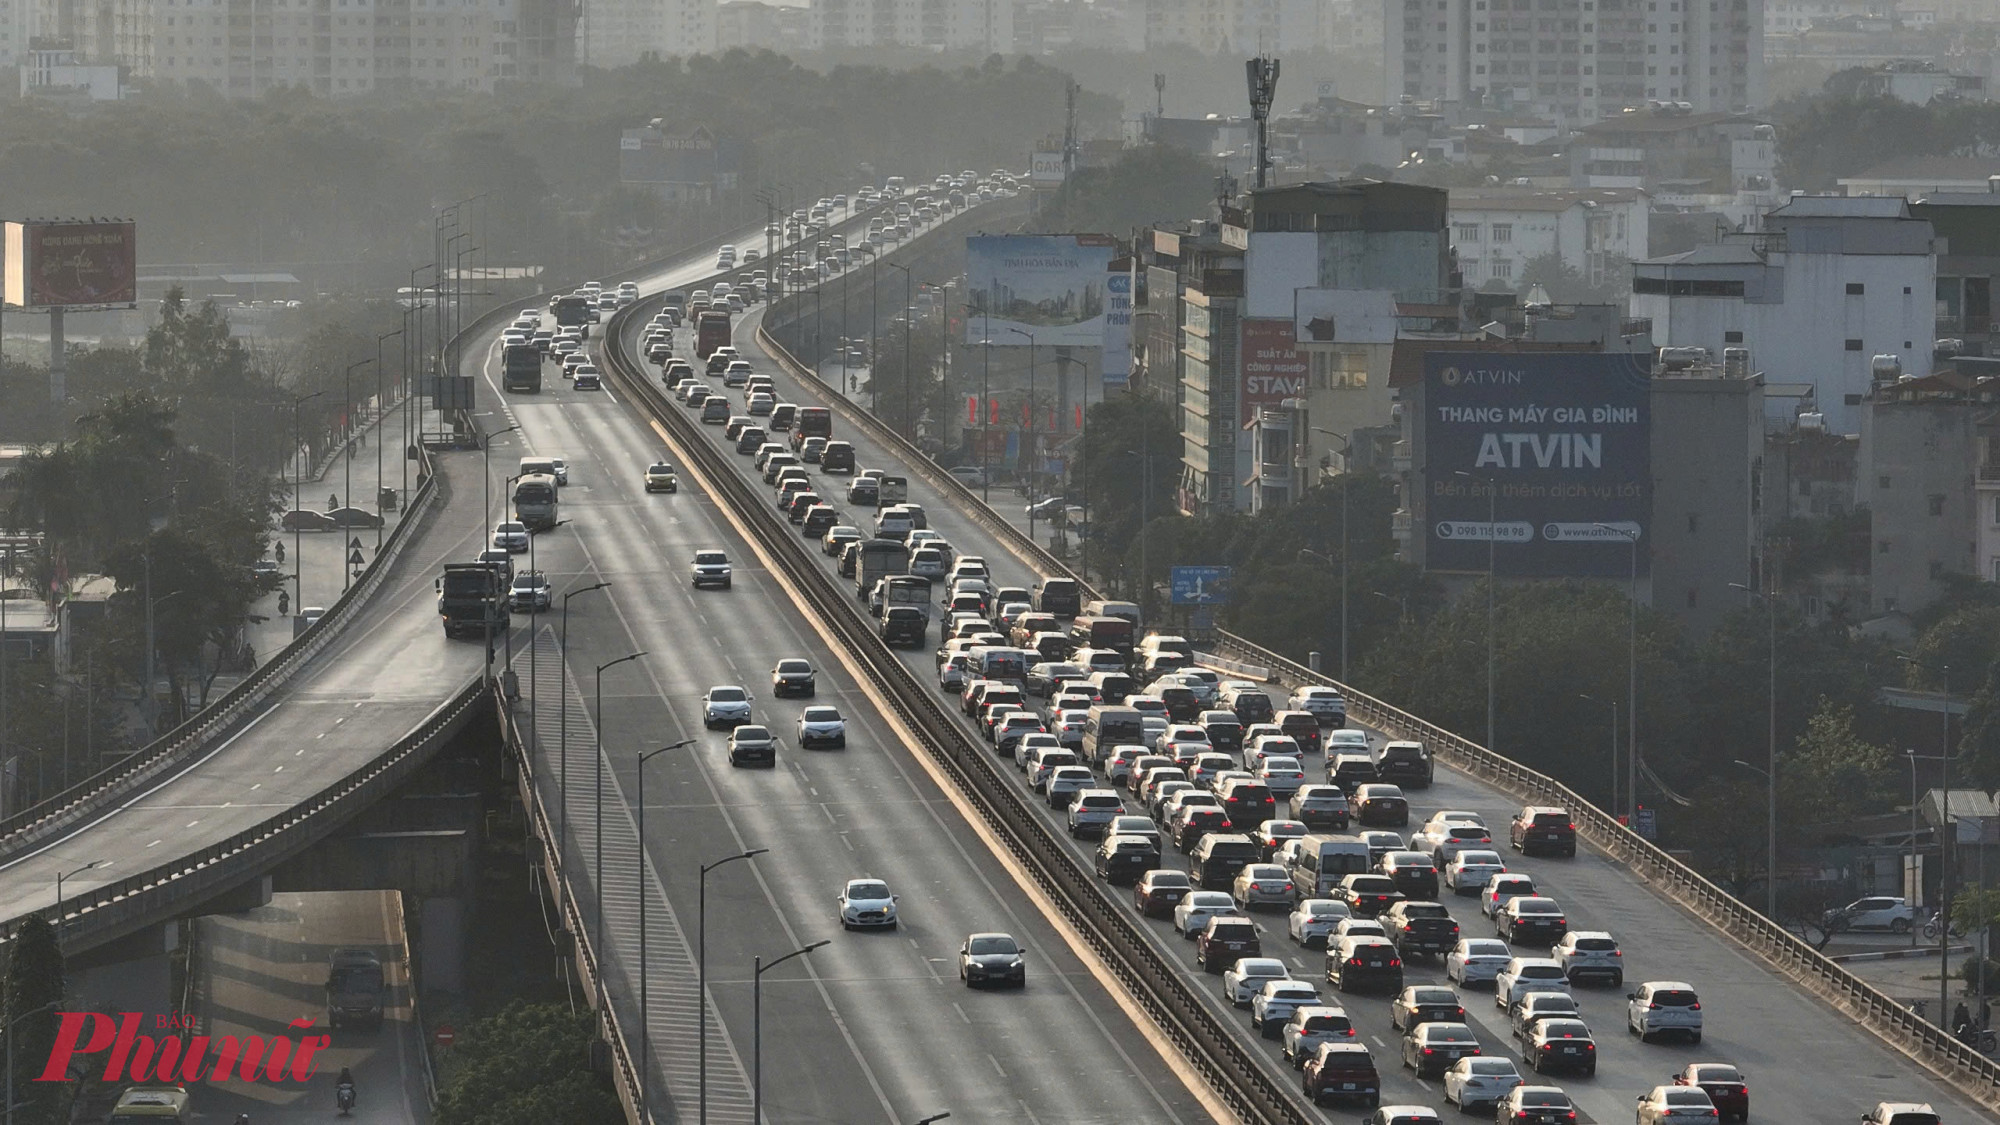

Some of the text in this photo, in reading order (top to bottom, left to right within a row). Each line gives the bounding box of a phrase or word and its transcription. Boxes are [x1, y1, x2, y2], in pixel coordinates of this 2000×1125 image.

[1463, 370, 1521, 384] ATVIN
[1439, 403, 1638, 423] THANG MÁY GIA ĐÌNH
[1474, 433, 1602, 468] ATVIN
[1502, 481, 1546, 496] thêm
[1551, 481, 1587, 500] dịch
[1593, 484, 1612, 500] vụ
[1617, 481, 1641, 497] tốt
[1457, 526, 1477, 537] 098
[1497, 526, 1509, 537] 98
[1512, 526, 1524, 537] 98
